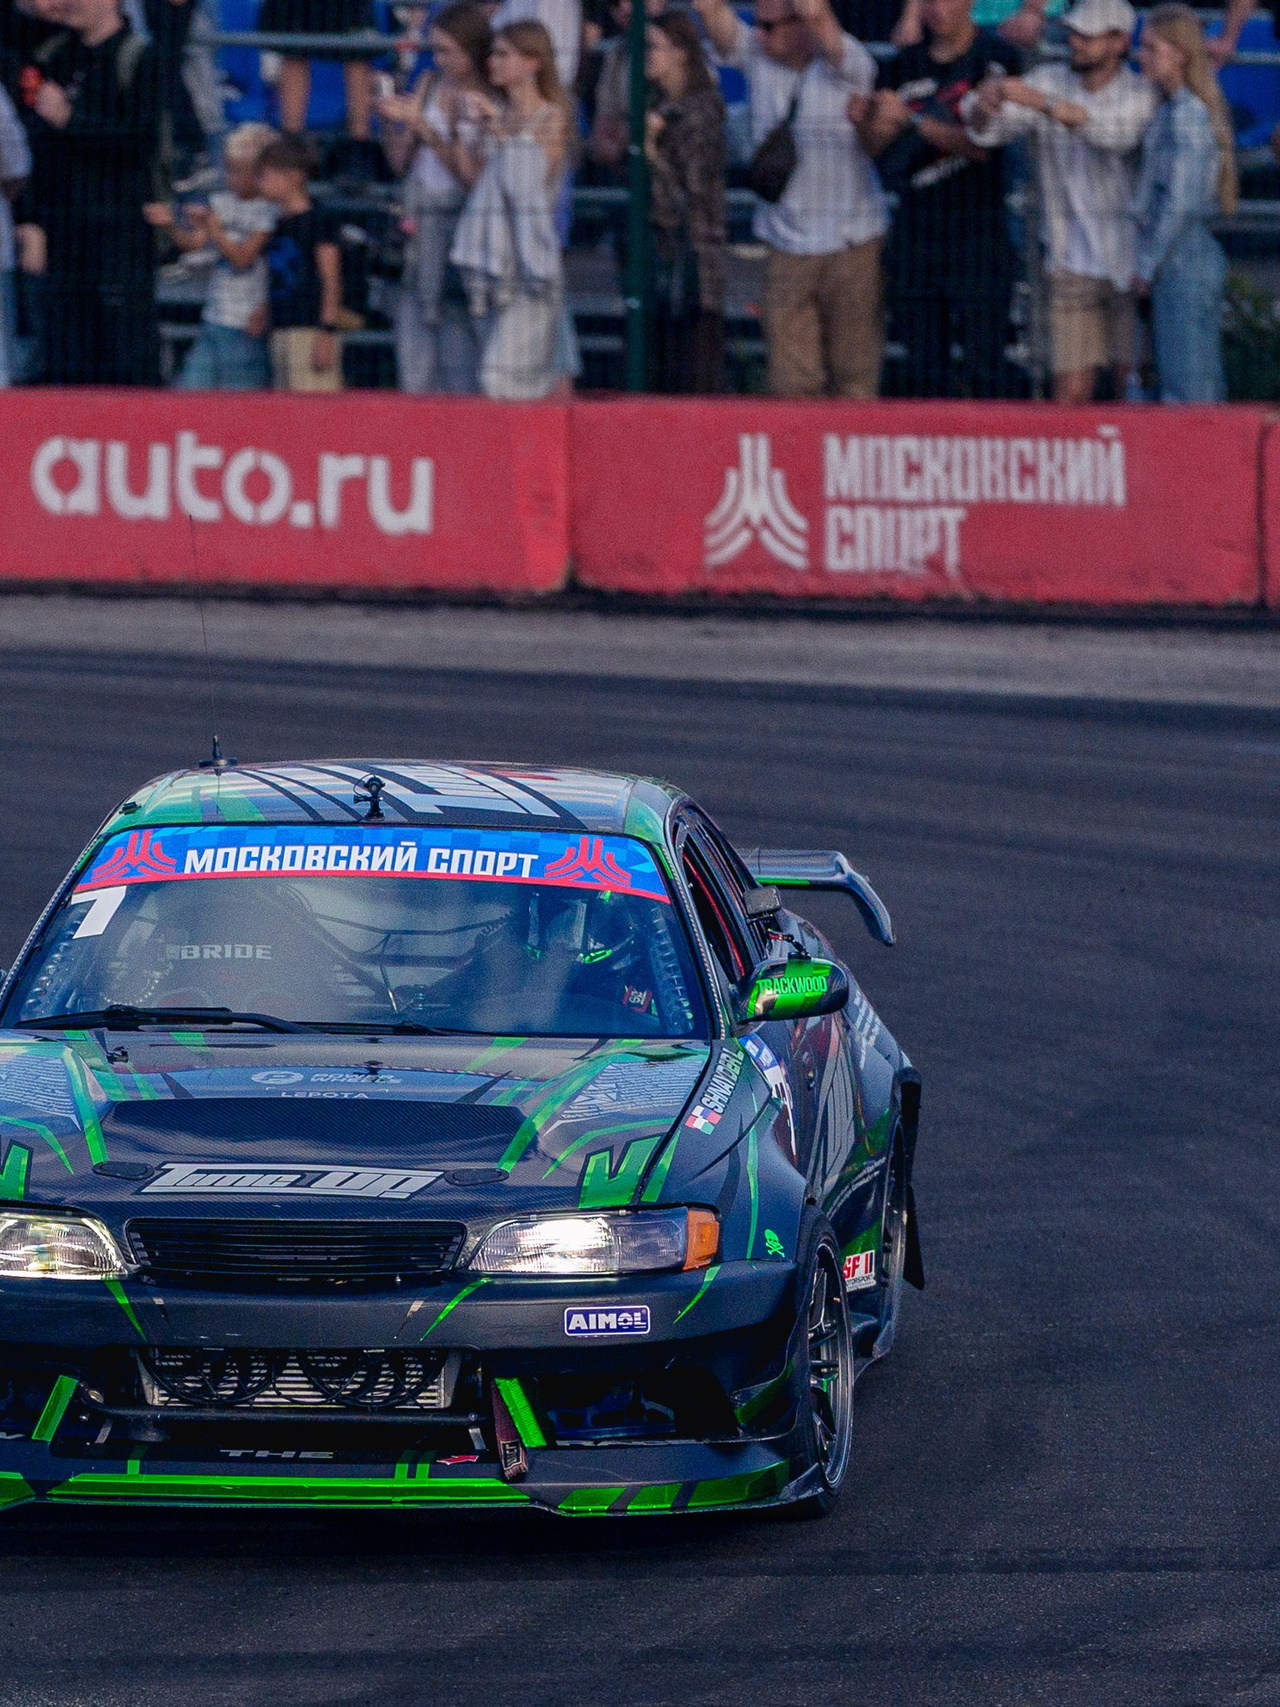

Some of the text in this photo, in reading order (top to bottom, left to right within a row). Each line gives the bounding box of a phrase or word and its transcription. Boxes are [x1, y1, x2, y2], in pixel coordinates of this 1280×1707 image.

[823, 424, 1126, 507] МОСКОВСКИЙ
[30, 430, 433, 535] auto.ru
[824, 506, 967, 578] СПОРТ
[184, 841, 539, 878] МОСКОВСКИЙ СПОРТ
[180, 944, 272, 960] BRIDE
[755, 976, 828, 996] TRACKWOOD
[281, 1091, 369, 1099] LEPOTA
[701, 1052, 742, 1114] SHNAYDER
[568, 1311, 647, 1330] AIMOL
[220, 1449, 333, 1459] THE
